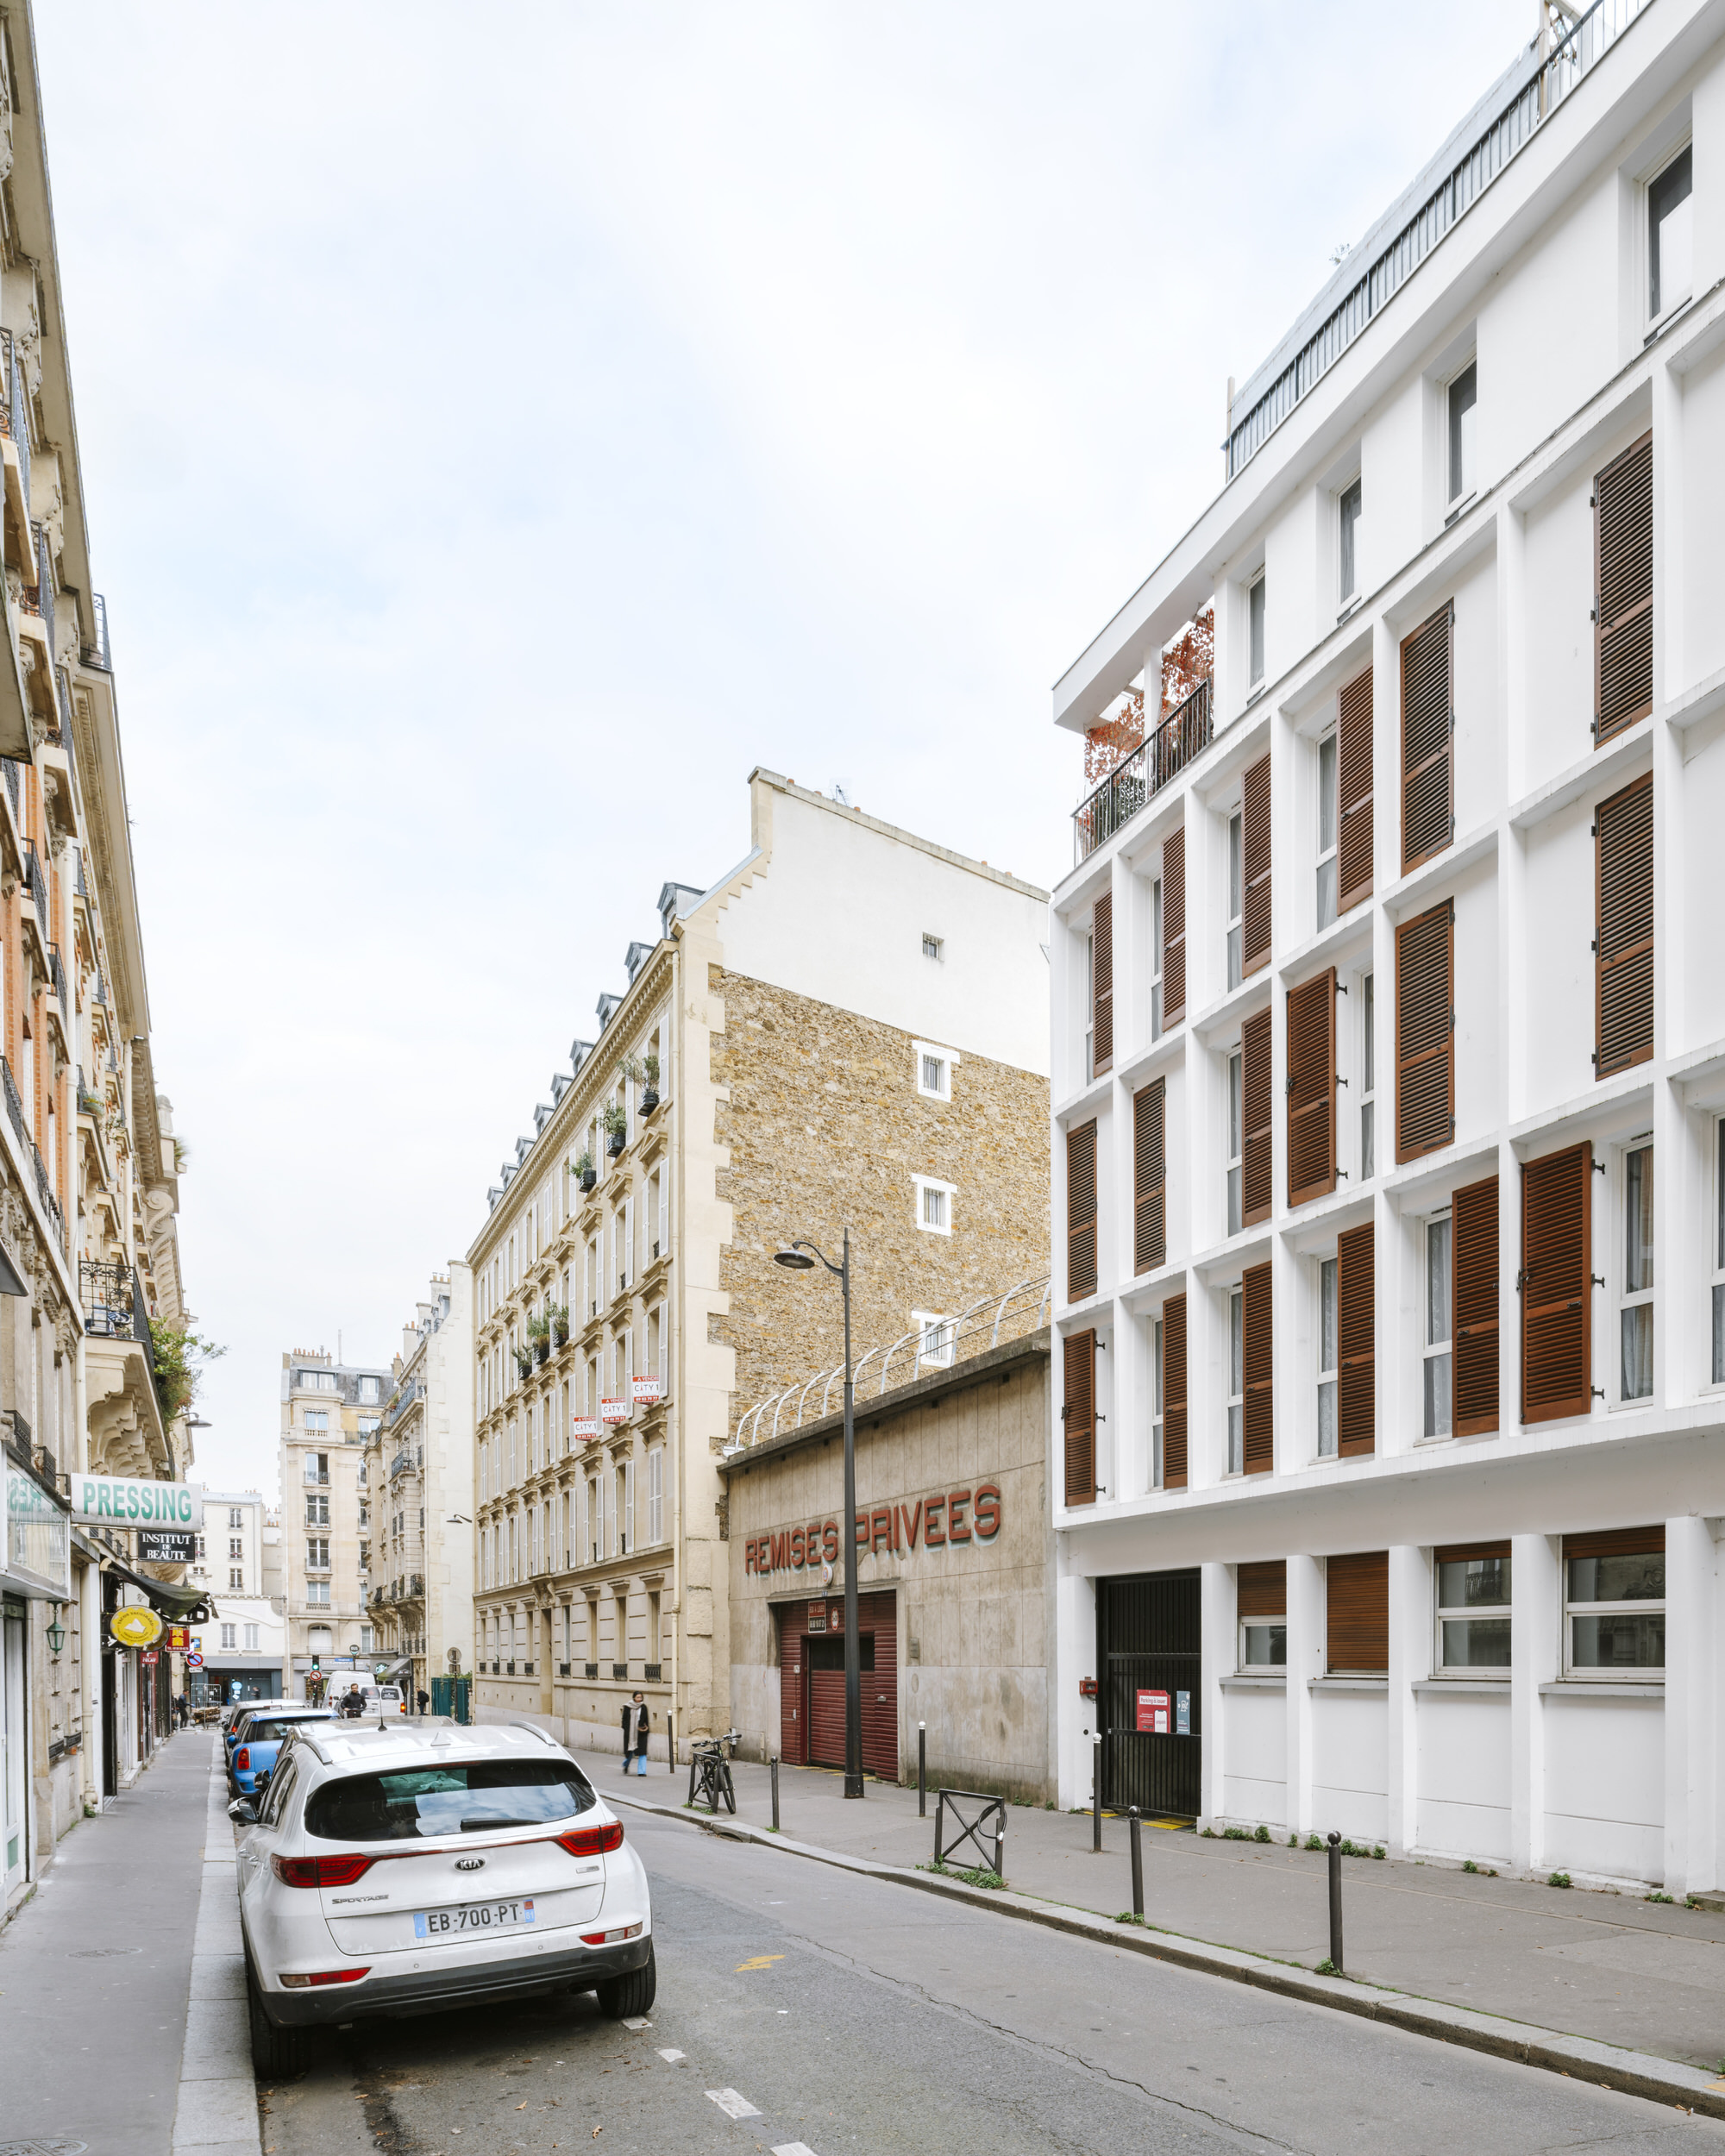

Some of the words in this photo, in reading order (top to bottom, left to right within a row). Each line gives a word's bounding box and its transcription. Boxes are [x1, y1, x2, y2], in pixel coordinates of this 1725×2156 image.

[83, 1482, 191, 1522] PRESSING
[142, 1533, 191, 1545] INSTITUT
[745, 1521, 838, 1574] REMISES
[147, 1550, 186, 1560] BEAUTE
[461, 1859, 480, 1870] KIA
[331, 1894, 389, 1904] SPORTAGE
